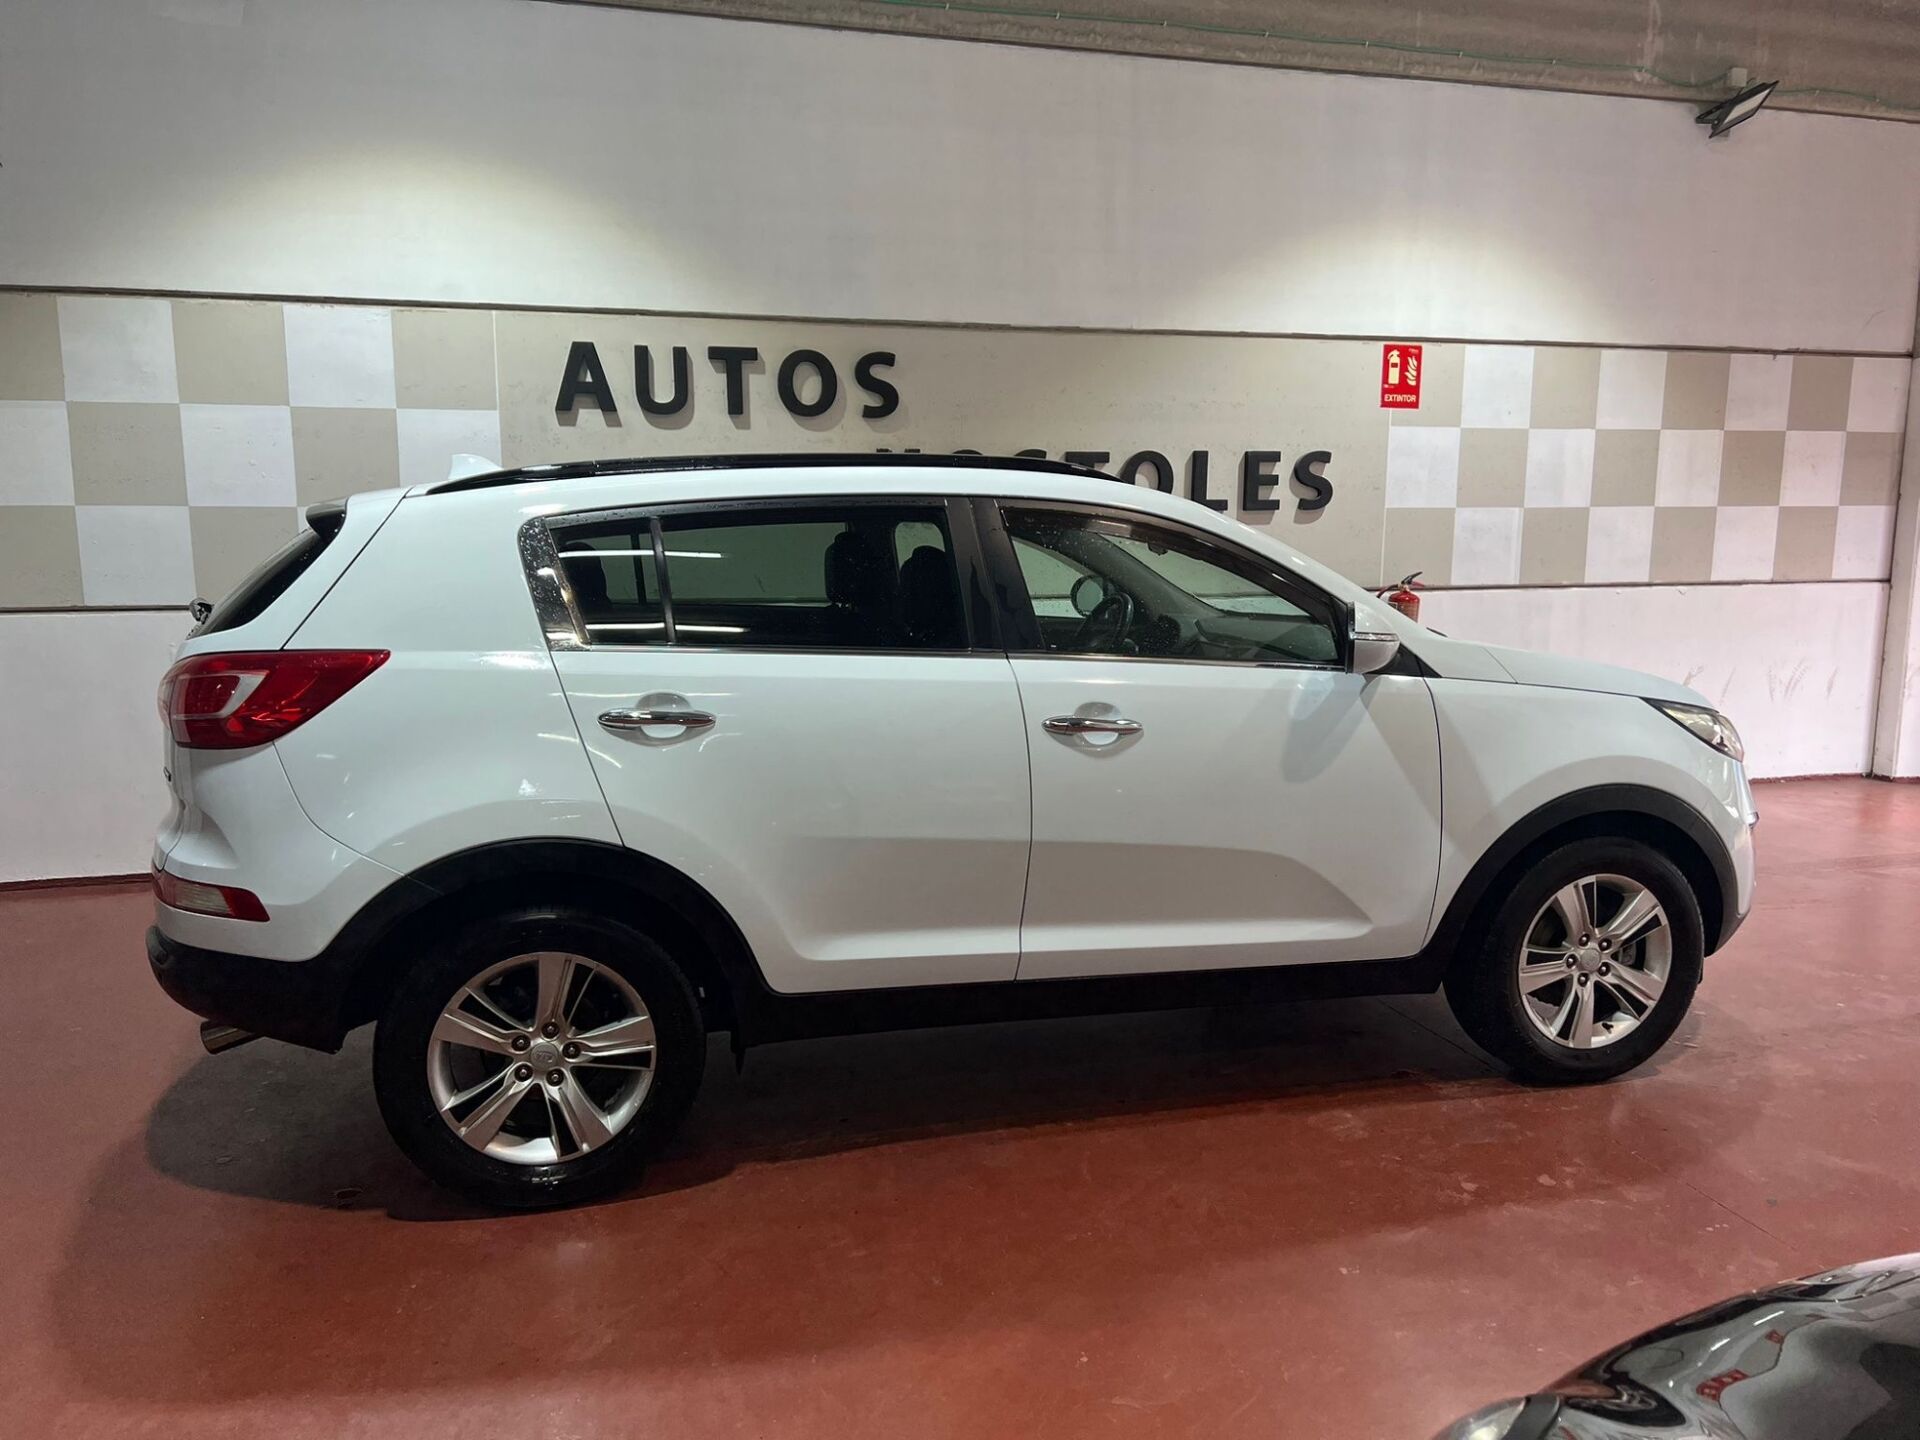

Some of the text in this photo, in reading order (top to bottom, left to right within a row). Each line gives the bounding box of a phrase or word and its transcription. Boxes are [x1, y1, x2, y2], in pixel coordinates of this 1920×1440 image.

[555, 341, 899, 419] AUTOS
[1384, 393, 1417, 403] EXTINTOR
[876, 447, 1333, 511] OLES
